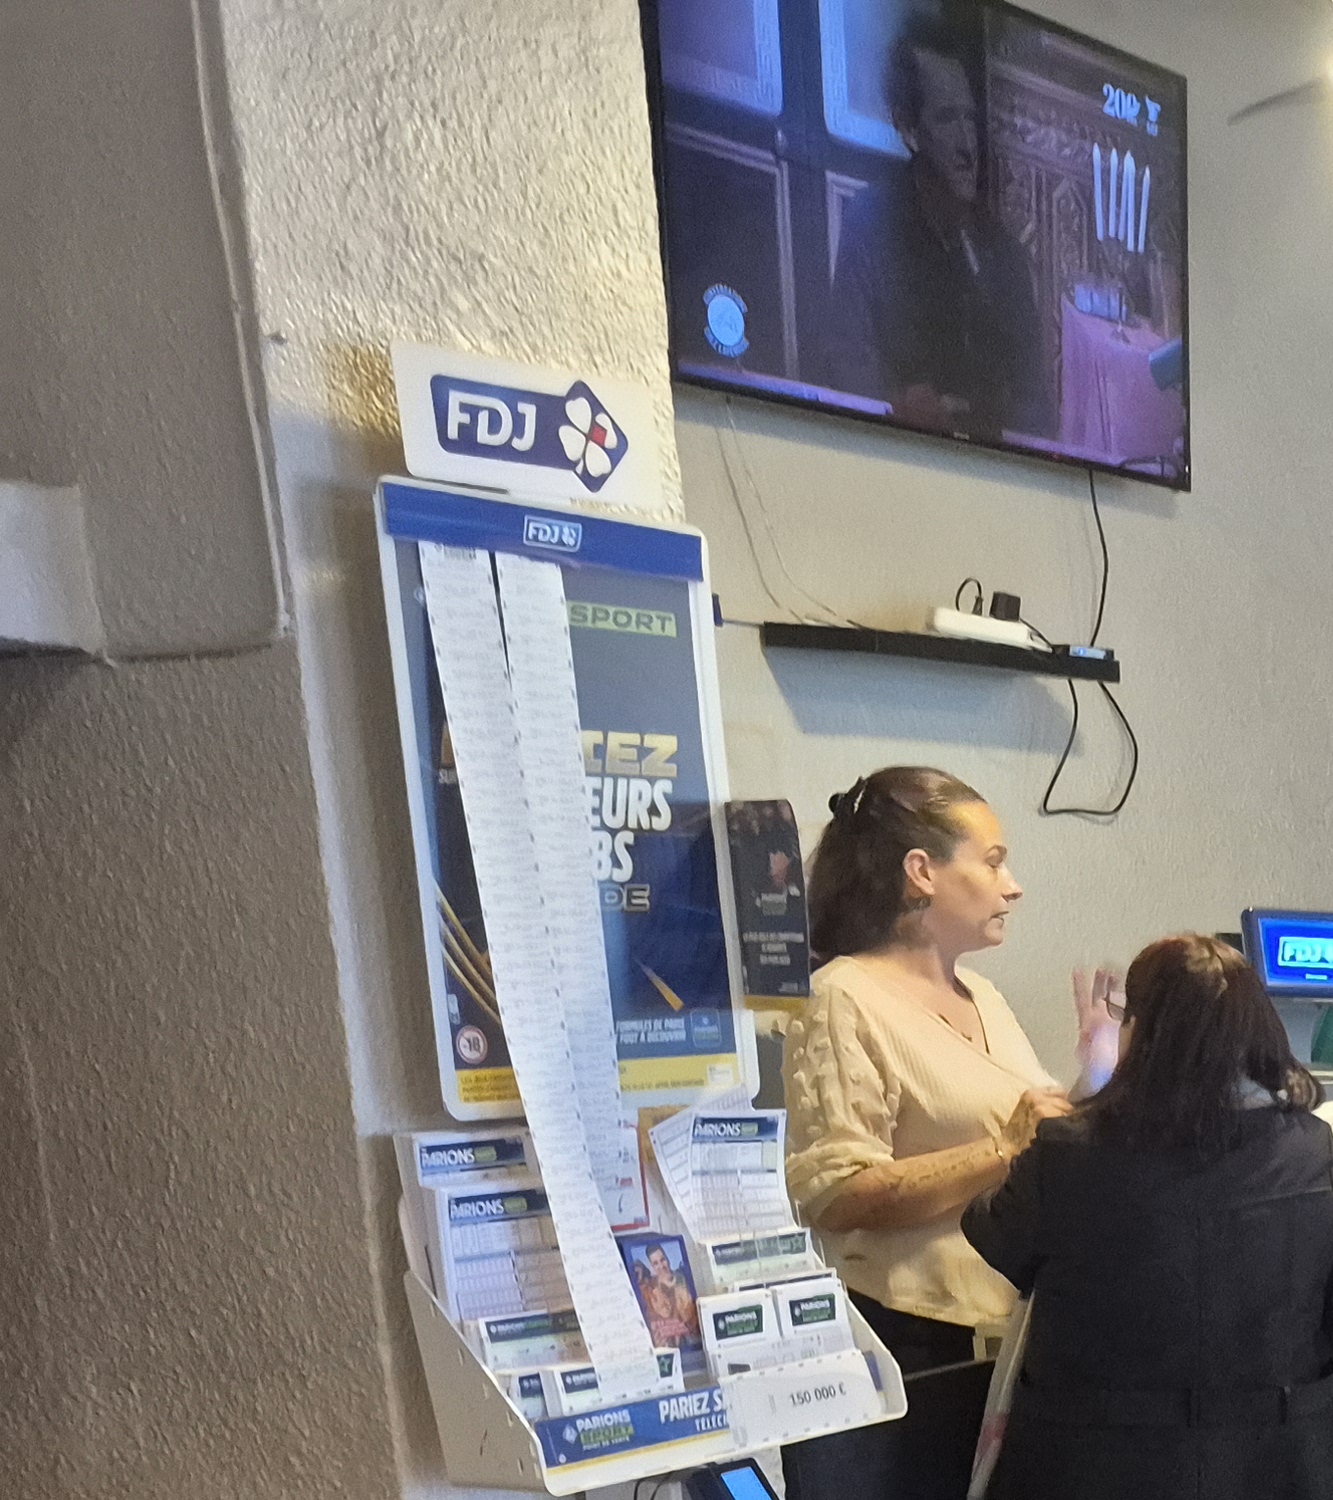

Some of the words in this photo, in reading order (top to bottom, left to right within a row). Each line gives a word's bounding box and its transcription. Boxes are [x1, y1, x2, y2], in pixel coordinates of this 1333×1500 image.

[447, 389, 537, 451] FDJ
[528, 521, 559, 543] FDJ
[570, 604, 673, 634] SPORT
[1283, 941, 1322, 963] FDJ
[420, 1148, 475, 1169] PARIONS
[450, 1199, 505, 1220] PARIONS
[790, 1391, 812, 1406] 150
[814, 1384, 836, 1401] 000
[839, 1382, 847, 1397] €
[658, 1391, 711, 1425] PARIEZ
[576, 1409, 632, 1433] PARIONS
